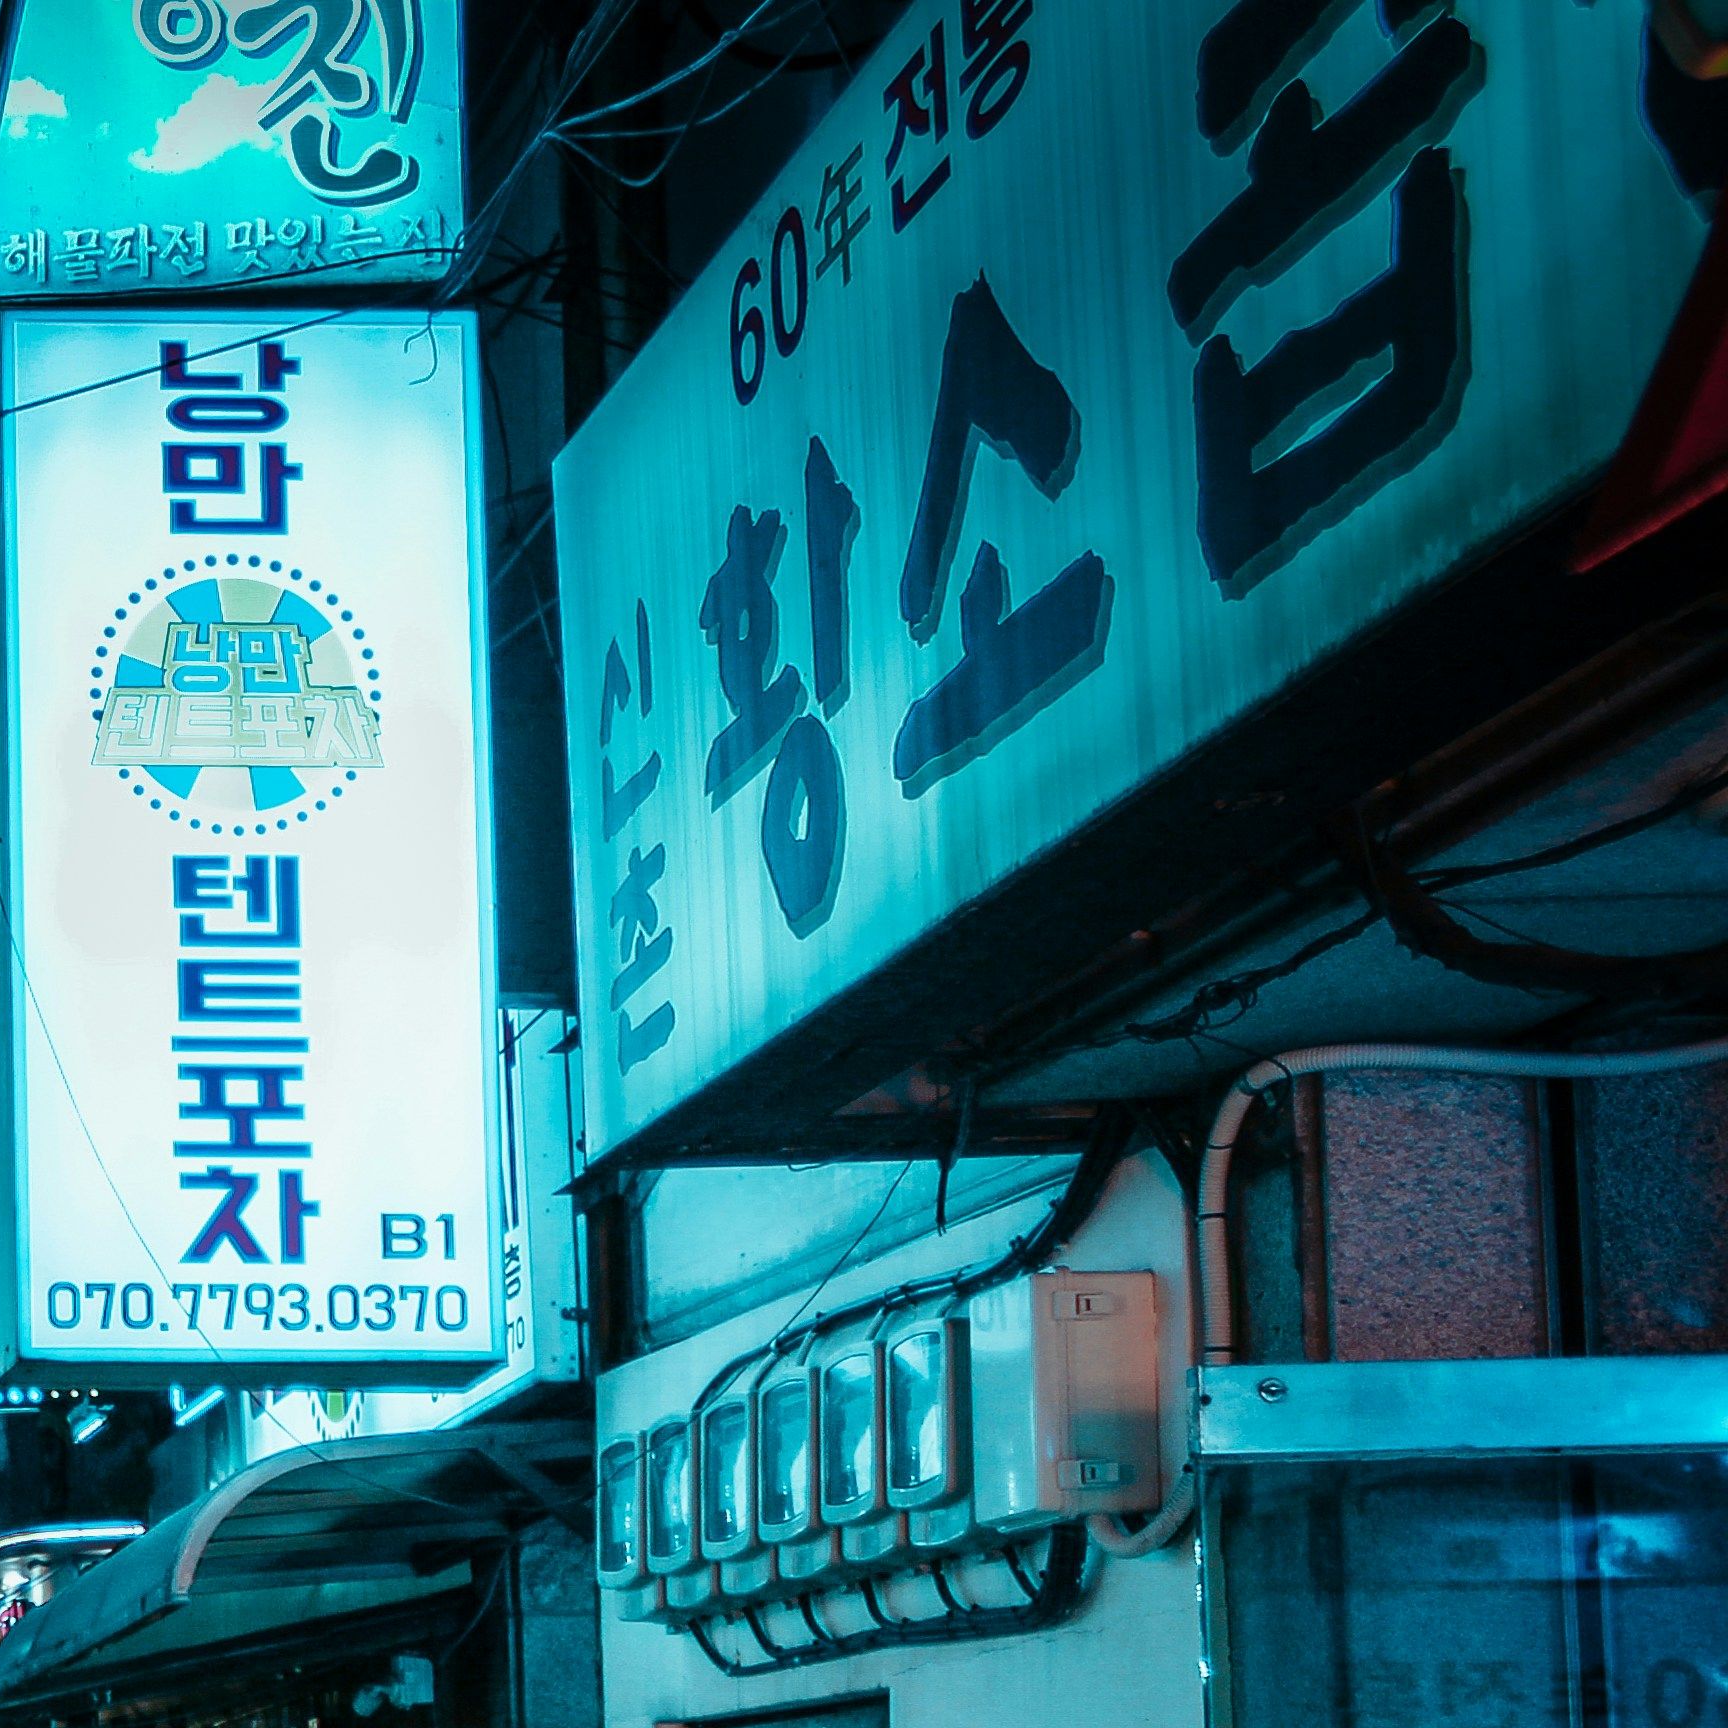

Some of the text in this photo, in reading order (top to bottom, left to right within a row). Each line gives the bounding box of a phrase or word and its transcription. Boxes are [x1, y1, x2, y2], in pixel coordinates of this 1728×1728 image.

[0, 222, 208, 285] 해물파전
[226, 213, 386, 275] 맛있는
[158, 340, 305, 535] 낭만
[173, 630, 302, 693] 낭만
[102, 694, 373, 758] 텐트포차
[171, 854, 320, 1265] 텐트포차
[380, 1212, 458, 1261] B1
[46, 1282, 470, 1334] 070.7793.0370
